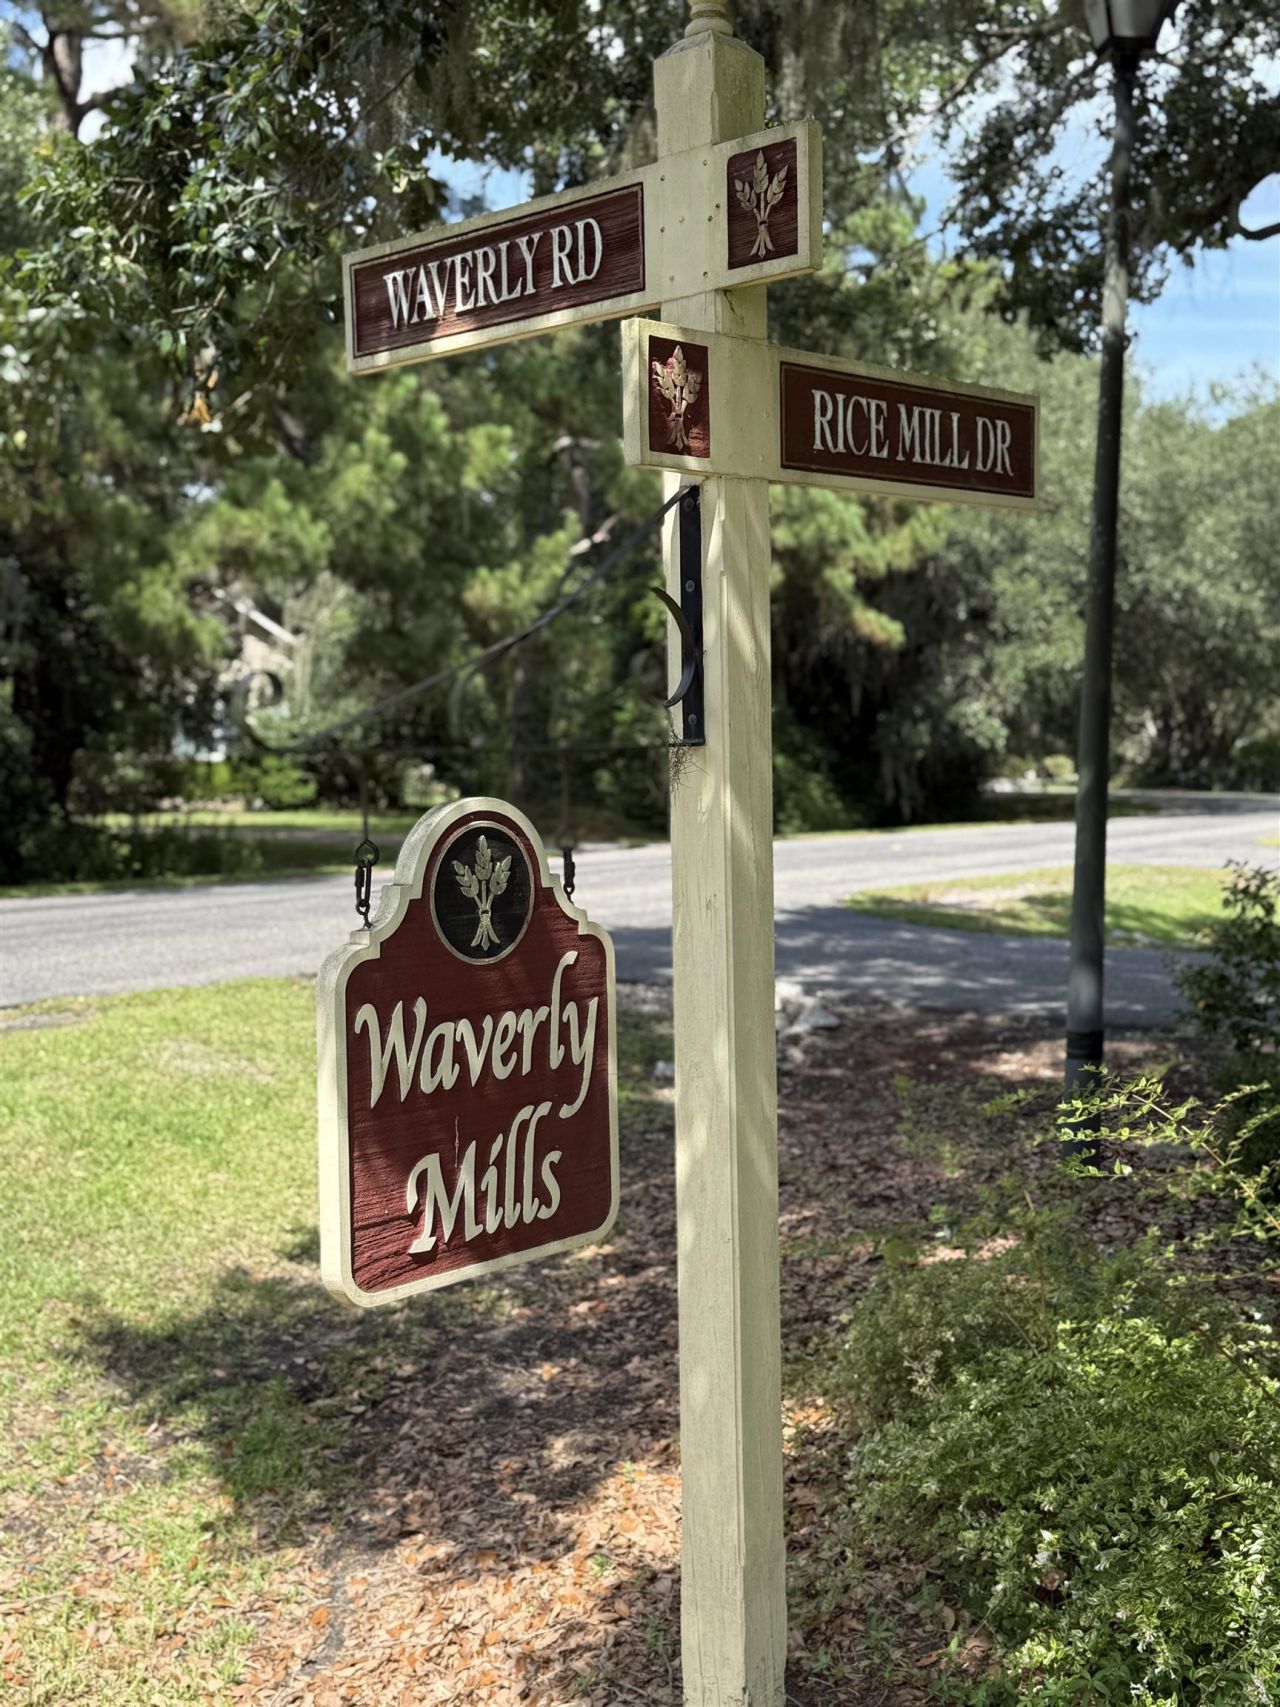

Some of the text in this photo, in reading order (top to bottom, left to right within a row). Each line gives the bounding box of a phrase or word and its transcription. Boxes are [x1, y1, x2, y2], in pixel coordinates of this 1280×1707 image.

[383, 218, 603, 329] WAVERLY RD
[811, 389, 1014, 477] RICE MILL DR
[354, 950, 599, 1119] Waverly
[406, 1101, 563, 1254] Mills
